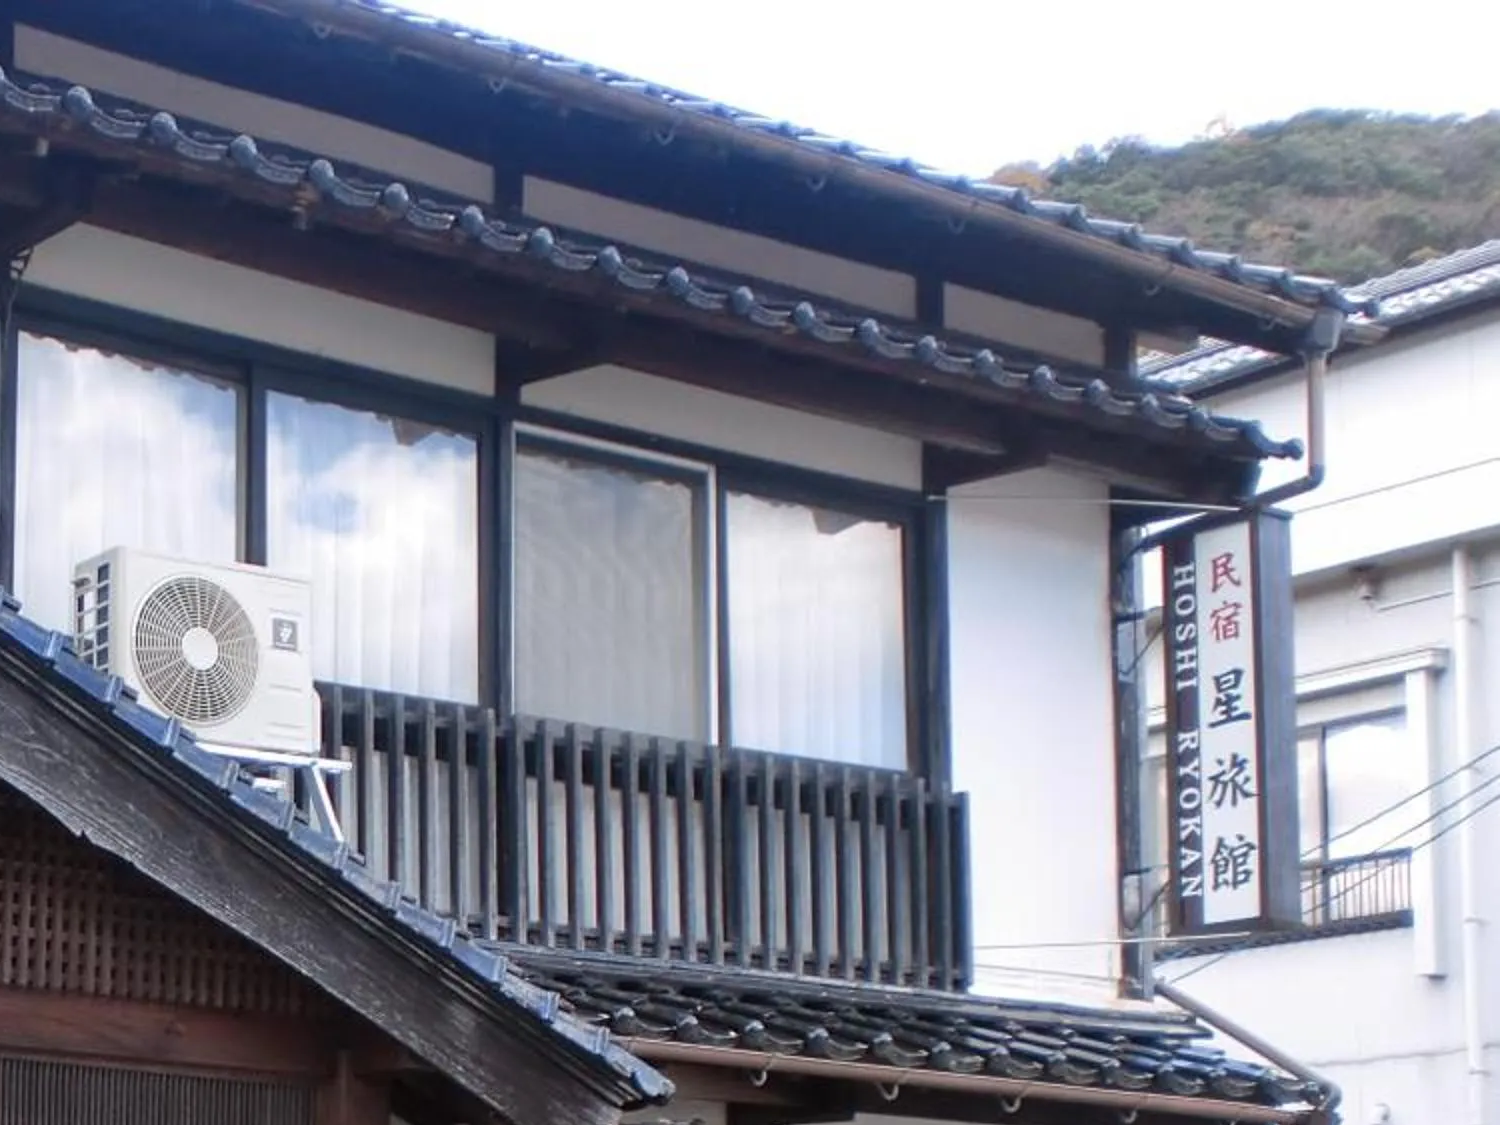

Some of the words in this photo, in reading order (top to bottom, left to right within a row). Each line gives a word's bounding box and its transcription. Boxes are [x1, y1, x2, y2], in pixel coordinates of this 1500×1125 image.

[1173, 564, 1198, 688] HOSHI
[1209, 551, 1242, 642] 民宿
[1176, 732, 1202, 898] RYOKAN
[1206, 668, 1258, 892] 星旅館
